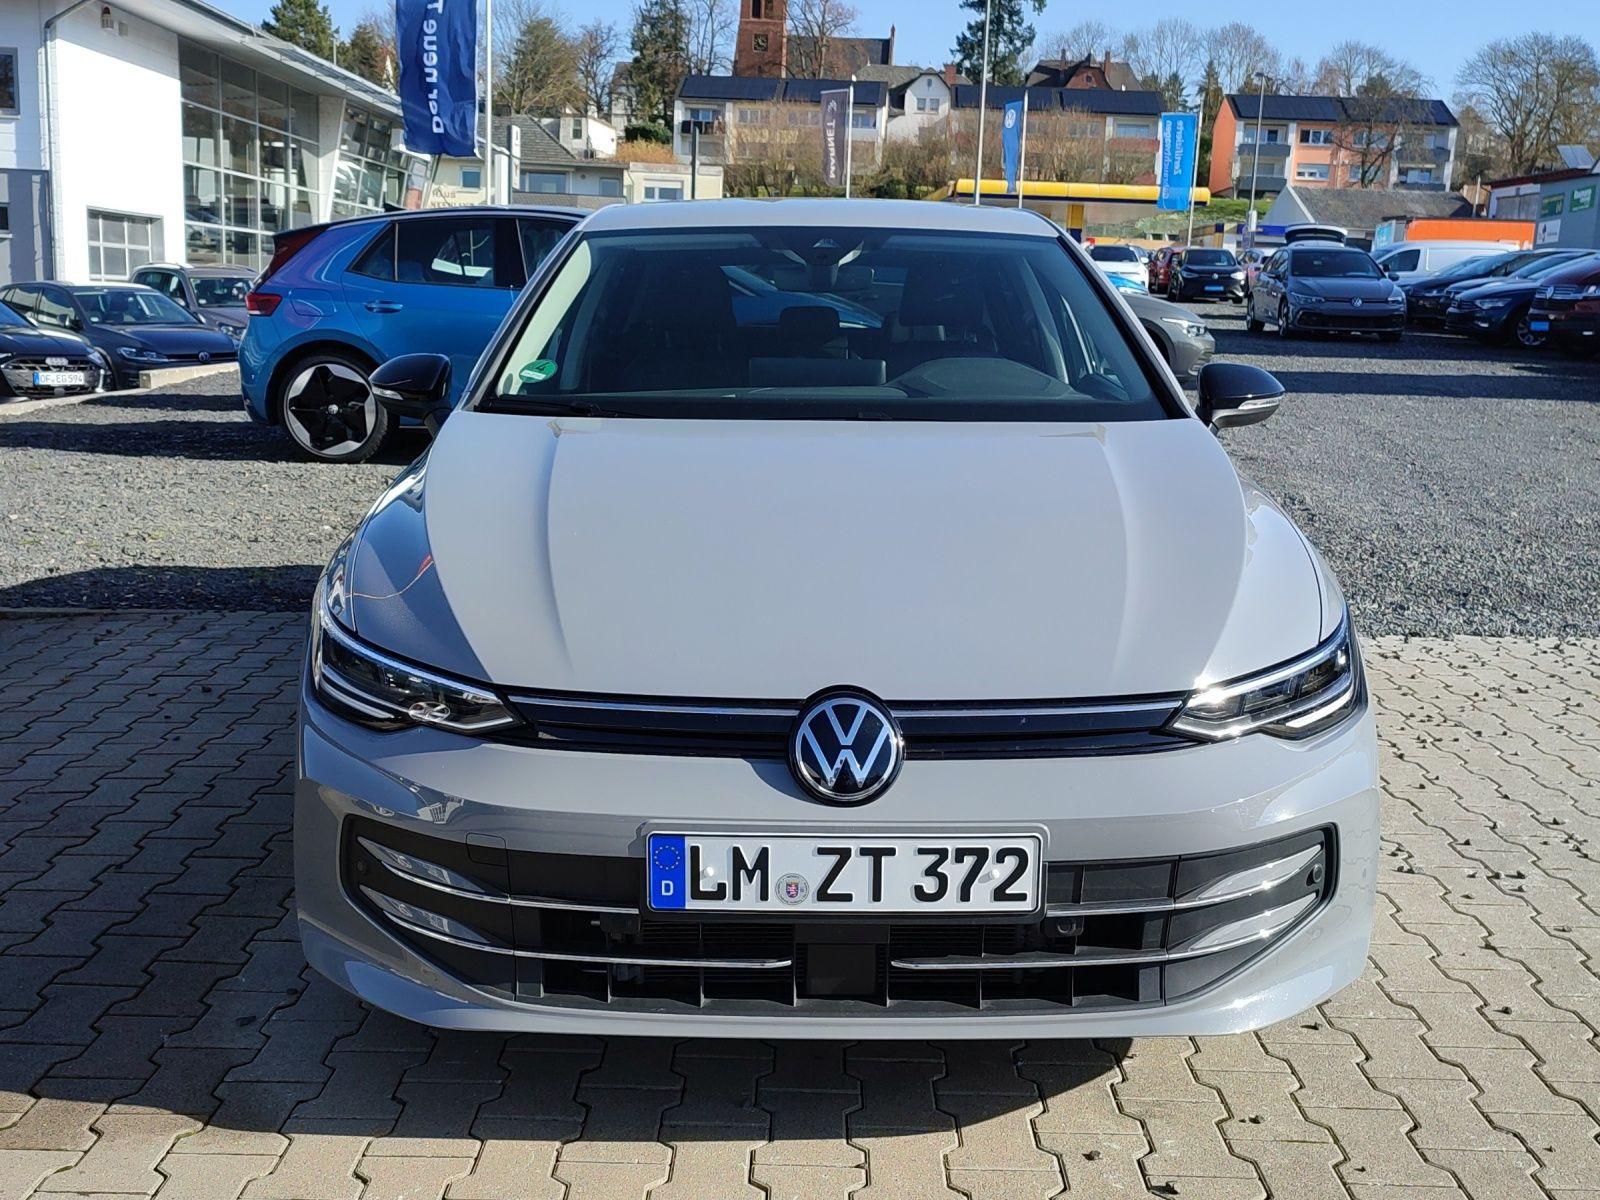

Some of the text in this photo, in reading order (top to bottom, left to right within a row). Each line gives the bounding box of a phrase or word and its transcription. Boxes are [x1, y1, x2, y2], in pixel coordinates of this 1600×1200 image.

[661, 880, 674, 896] D
[690, 846, 769, 901] LM
[817, 847, 896, 902] ZT
[914, 847, 1029, 902] 372
